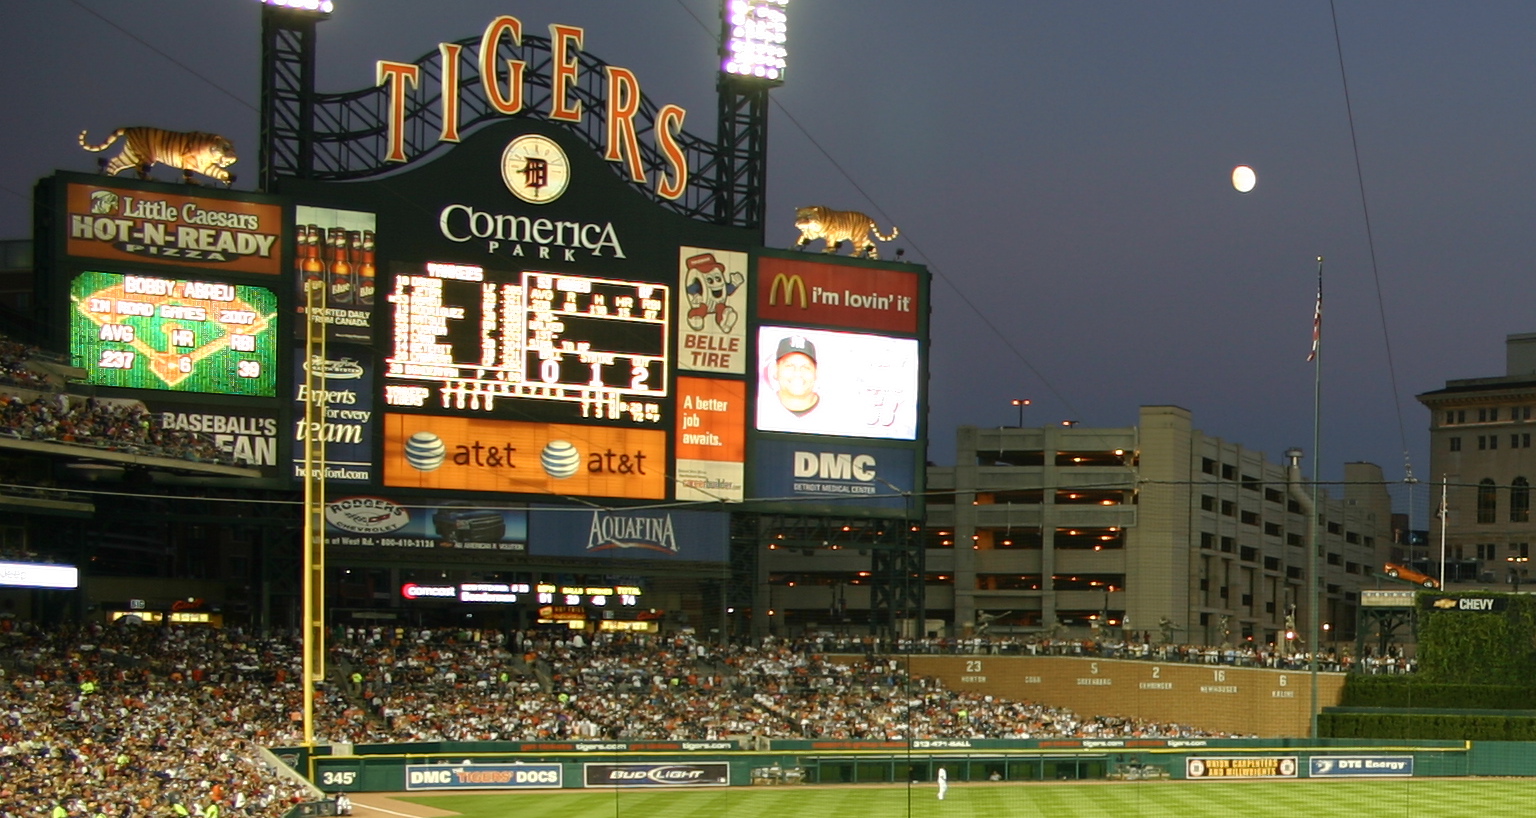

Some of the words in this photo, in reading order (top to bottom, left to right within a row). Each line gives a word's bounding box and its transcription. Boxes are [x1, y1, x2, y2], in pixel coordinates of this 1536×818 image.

[376, 14, 689, 200] TIGERS
[123, 195, 178, 222] Little
[182, 203, 258, 230] Caesars
[71, 215, 279, 257] HOT-N-READY
[126, 244, 226, 262] PIZZA
[489, 242, 575, 261] PARK
[124, 276, 176, 296] BOBBY
[184, 281, 235, 301] ABREU
[615, 297, 632, 308] HR
[812, 287, 840, 306] i'm
[845, 291, 893, 311] lovin'
[897, 294, 910, 312] it
[117, 301, 154, 317] ROAD
[160, 306, 206, 321] GAMES
[220, 310, 256, 324] 2007
[348, 310, 370, 320] DAILY
[100, 324, 134, 342] AVG
[172, 329, 195, 347] HR
[230, 335, 256, 351] RBI
[684, 334, 739, 352] BELLE
[179, 355, 191, 373] 6
[690, 351, 730, 368] TIRE
[541, 359, 559, 384] 0
[589, 363, 604, 387] 1
[631, 366, 649, 390] 2
[683, 395, 692, 409] A
[695, 396, 728, 411] better
[162, 412, 277, 436] BASEBALL'S
[341, 410, 371, 423] every
[683, 413, 700, 429] job
[296, 417, 363, 444] team
[682, 431, 722, 446] awaits.
[214, 434, 277, 466] FAN
[453, 440, 517, 468] at&t
[587, 448, 647, 476] at&t
[794, 451, 876, 482] DMC
[794, 483, 821, 492] DETROIT
[822, 484, 850, 493] MEDICAL
[852, 485, 876, 494] CENTER
[330, 498, 404, 516] RODGERS
[336, 521, 398, 533] CHEVROLET
[586, 511, 677, 551] AQUAFINA
[617, 586, 642, 595] TOTAL
[1459, 599, 1494, 610] CHEVY
[966, 660, 982, 672] 23
[1091, 662, 1098, 674] 5
[1152, 667, 1160, 679] 2
[1214, 670, 1225, 682] 16
[1279, 675, 1287, 687] 6
[575, 743, 627, 752] tigers.com
[682, 741, 731, 751] tigers.com
[1338, 760, 1362, 769] DTE
[1365, 760, 1404, 770] Energy
[323, 771, 356, 785] 345'
[410, 771, 451, 784] DMC
[457, 772, 515, 783] TIGERS'
[516, 771, 558, 783] DOCS
